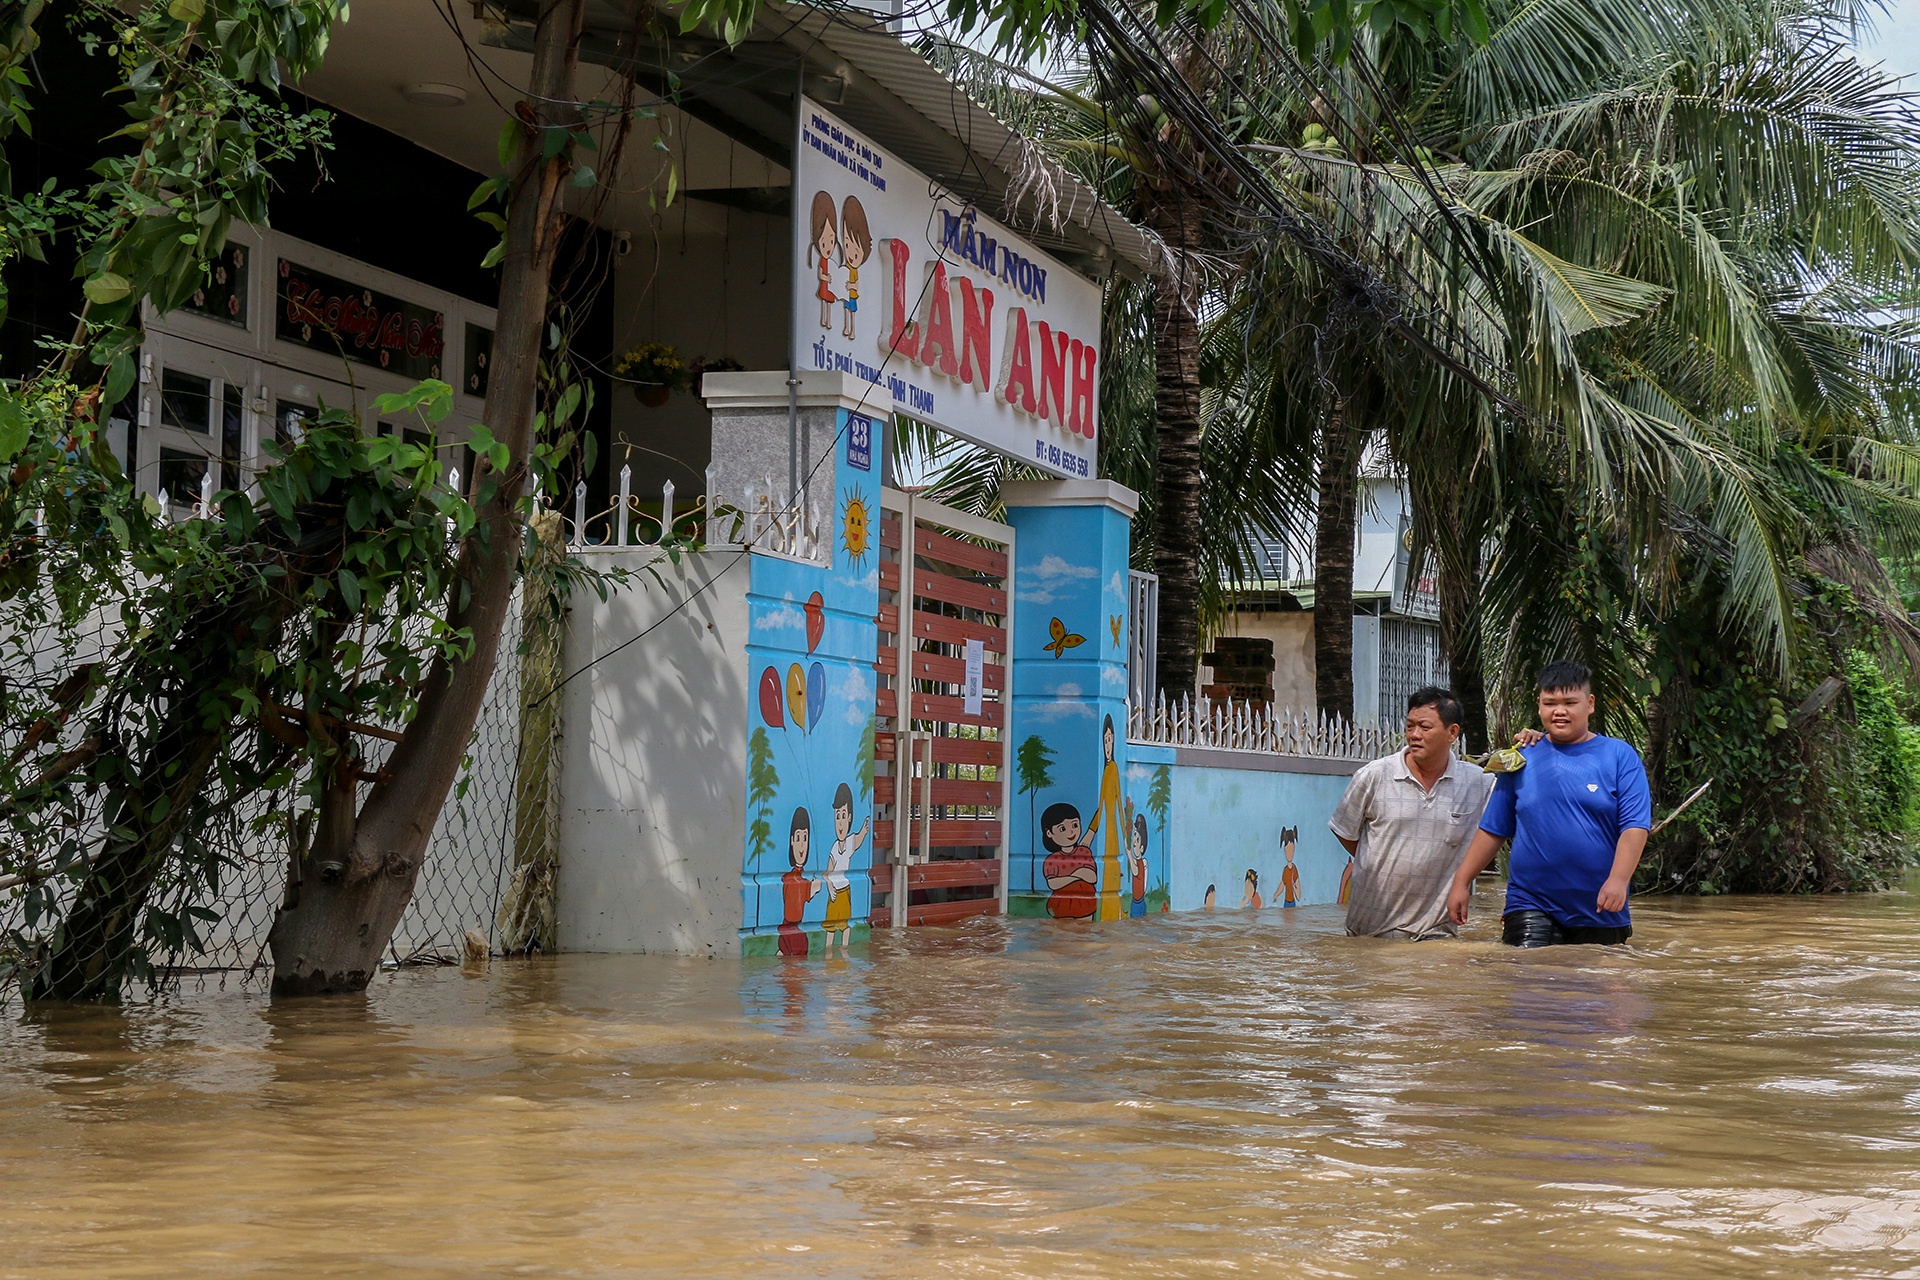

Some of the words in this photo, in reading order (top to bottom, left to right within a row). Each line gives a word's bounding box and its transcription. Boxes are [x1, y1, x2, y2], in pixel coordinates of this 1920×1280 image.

[811, 134, 822, 152] BAN
[844, 135, 855, 153] DỤC
[856, 142, 861, 156] &
[872, 153, 883, 170] TẠO
[943, 208, 997, 276] MẦM
[1003, 246, 1047, 304] NON
[887, 238, 995, 392] LAN
[1004, 307, 1097, 439] ANH
[813, 335, 826, 369] TỔ
[826, 349, 833, 371] 5
[887, 372, 906, 403] VĨNH
[909, 384, 934, 414] THẠNH
[852, 419, 868, 448] 23
[1048, 444, 1061, 466] 058
